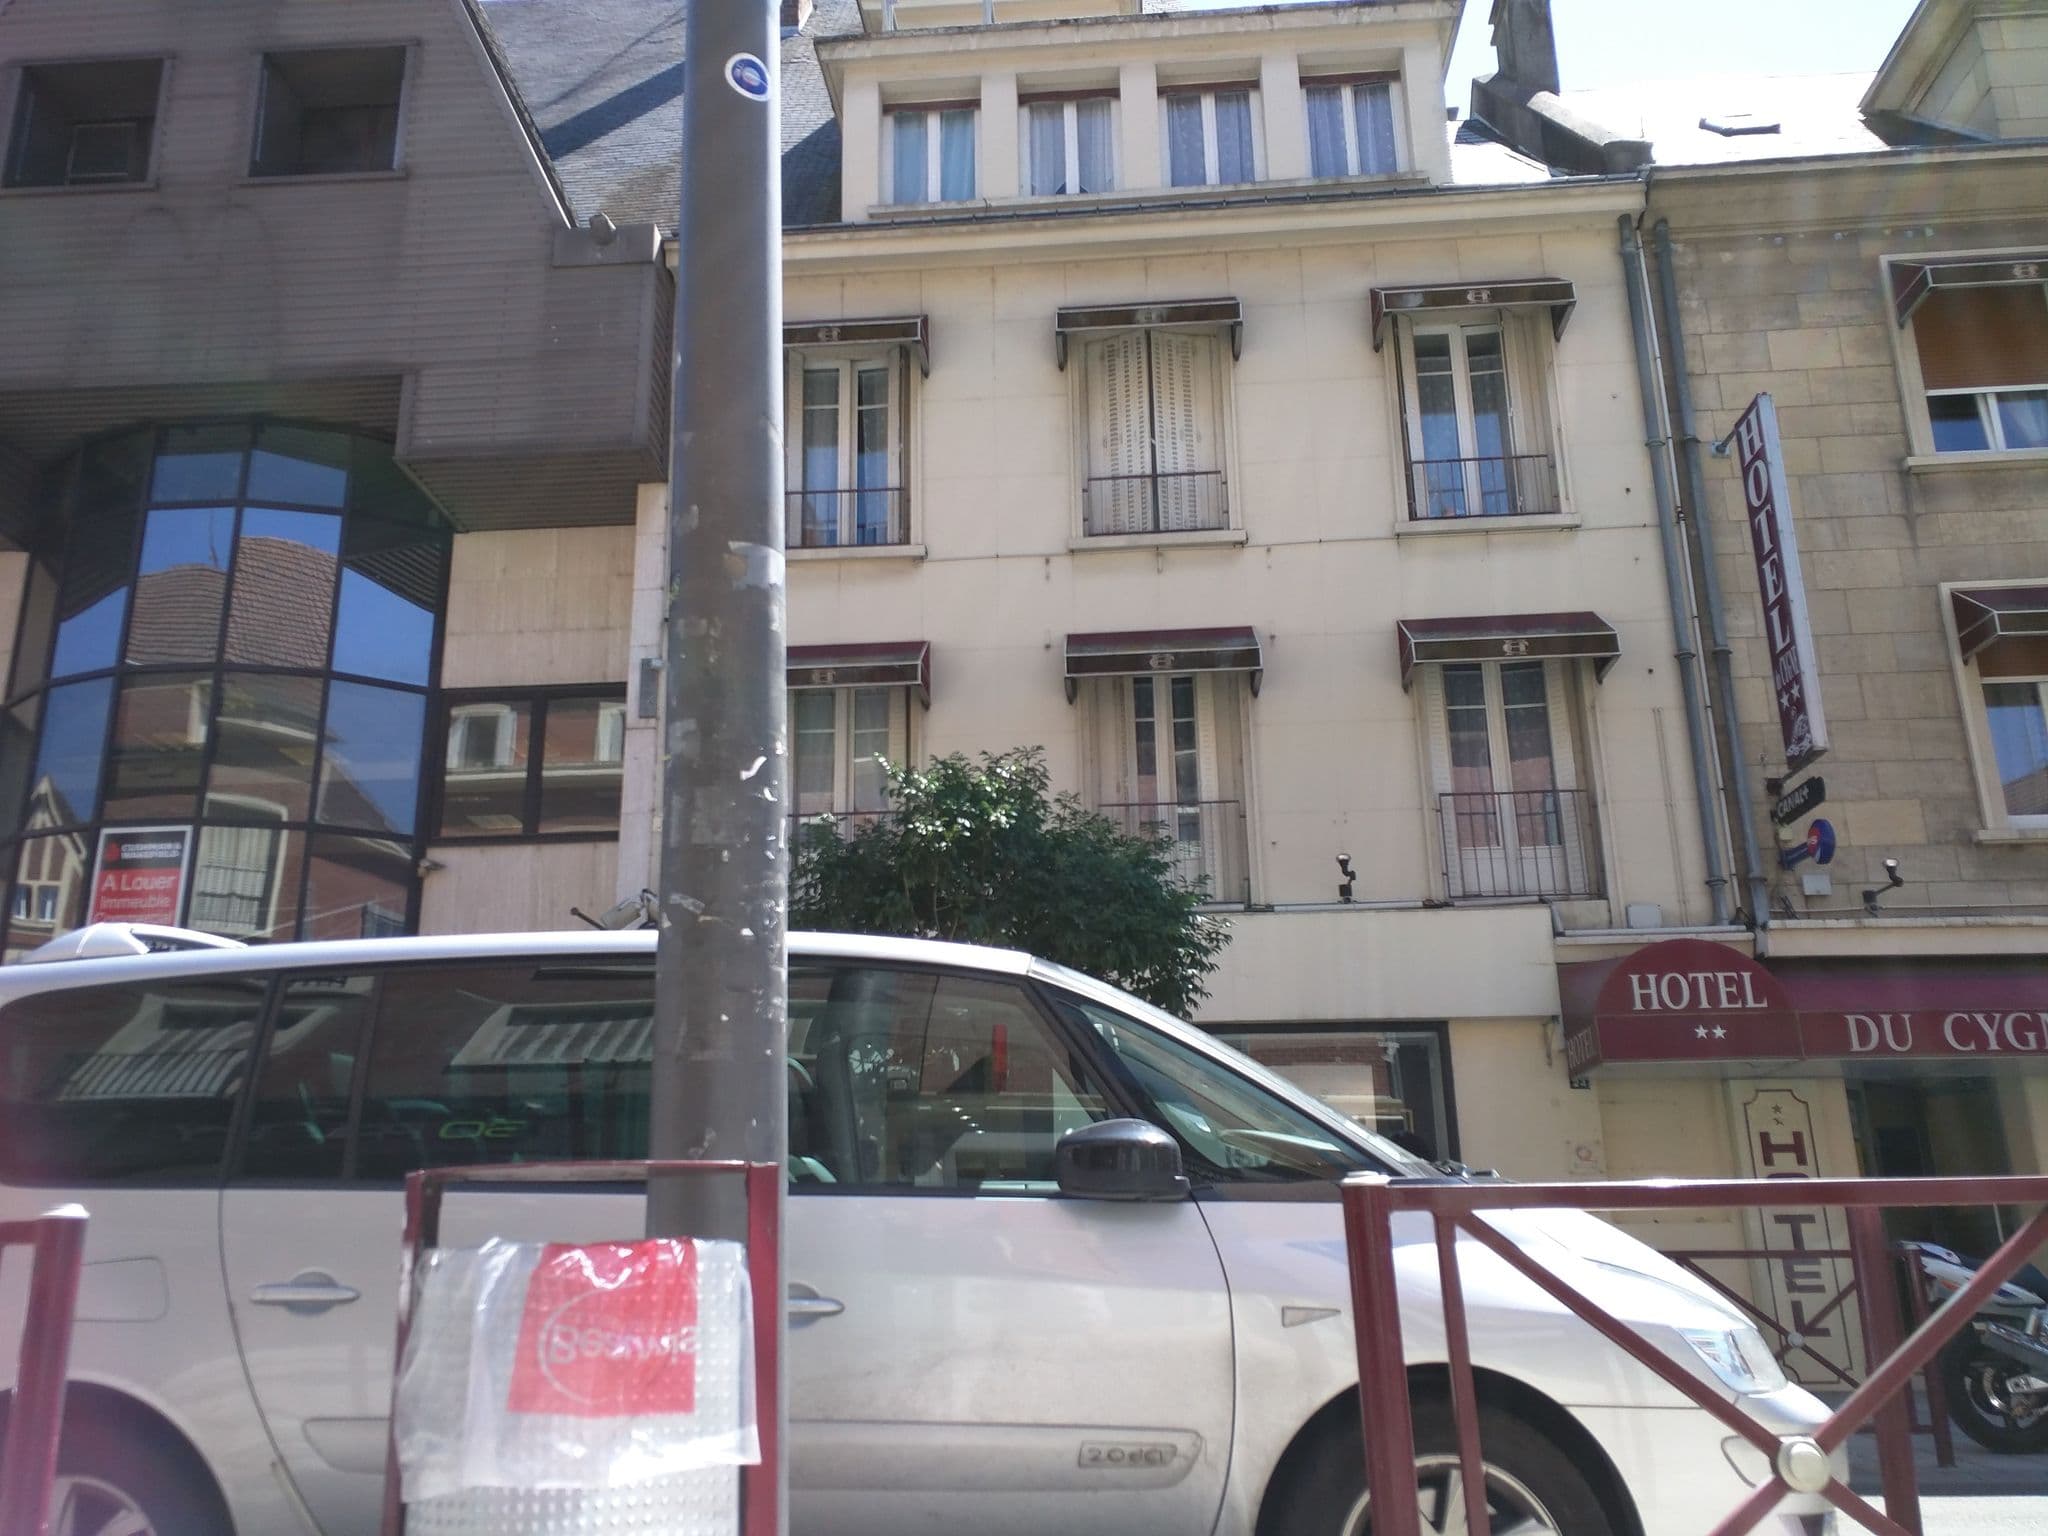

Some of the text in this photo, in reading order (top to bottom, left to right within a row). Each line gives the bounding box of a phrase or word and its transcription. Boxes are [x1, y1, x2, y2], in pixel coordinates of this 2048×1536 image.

[1738, 406, 1791, 653] HOTEL
[1628, 971, 1768, 1011] HOTEL
[1844, 1013, 1912, 1052] DU
[1759, 1130, 1831, 1337] HTEL
